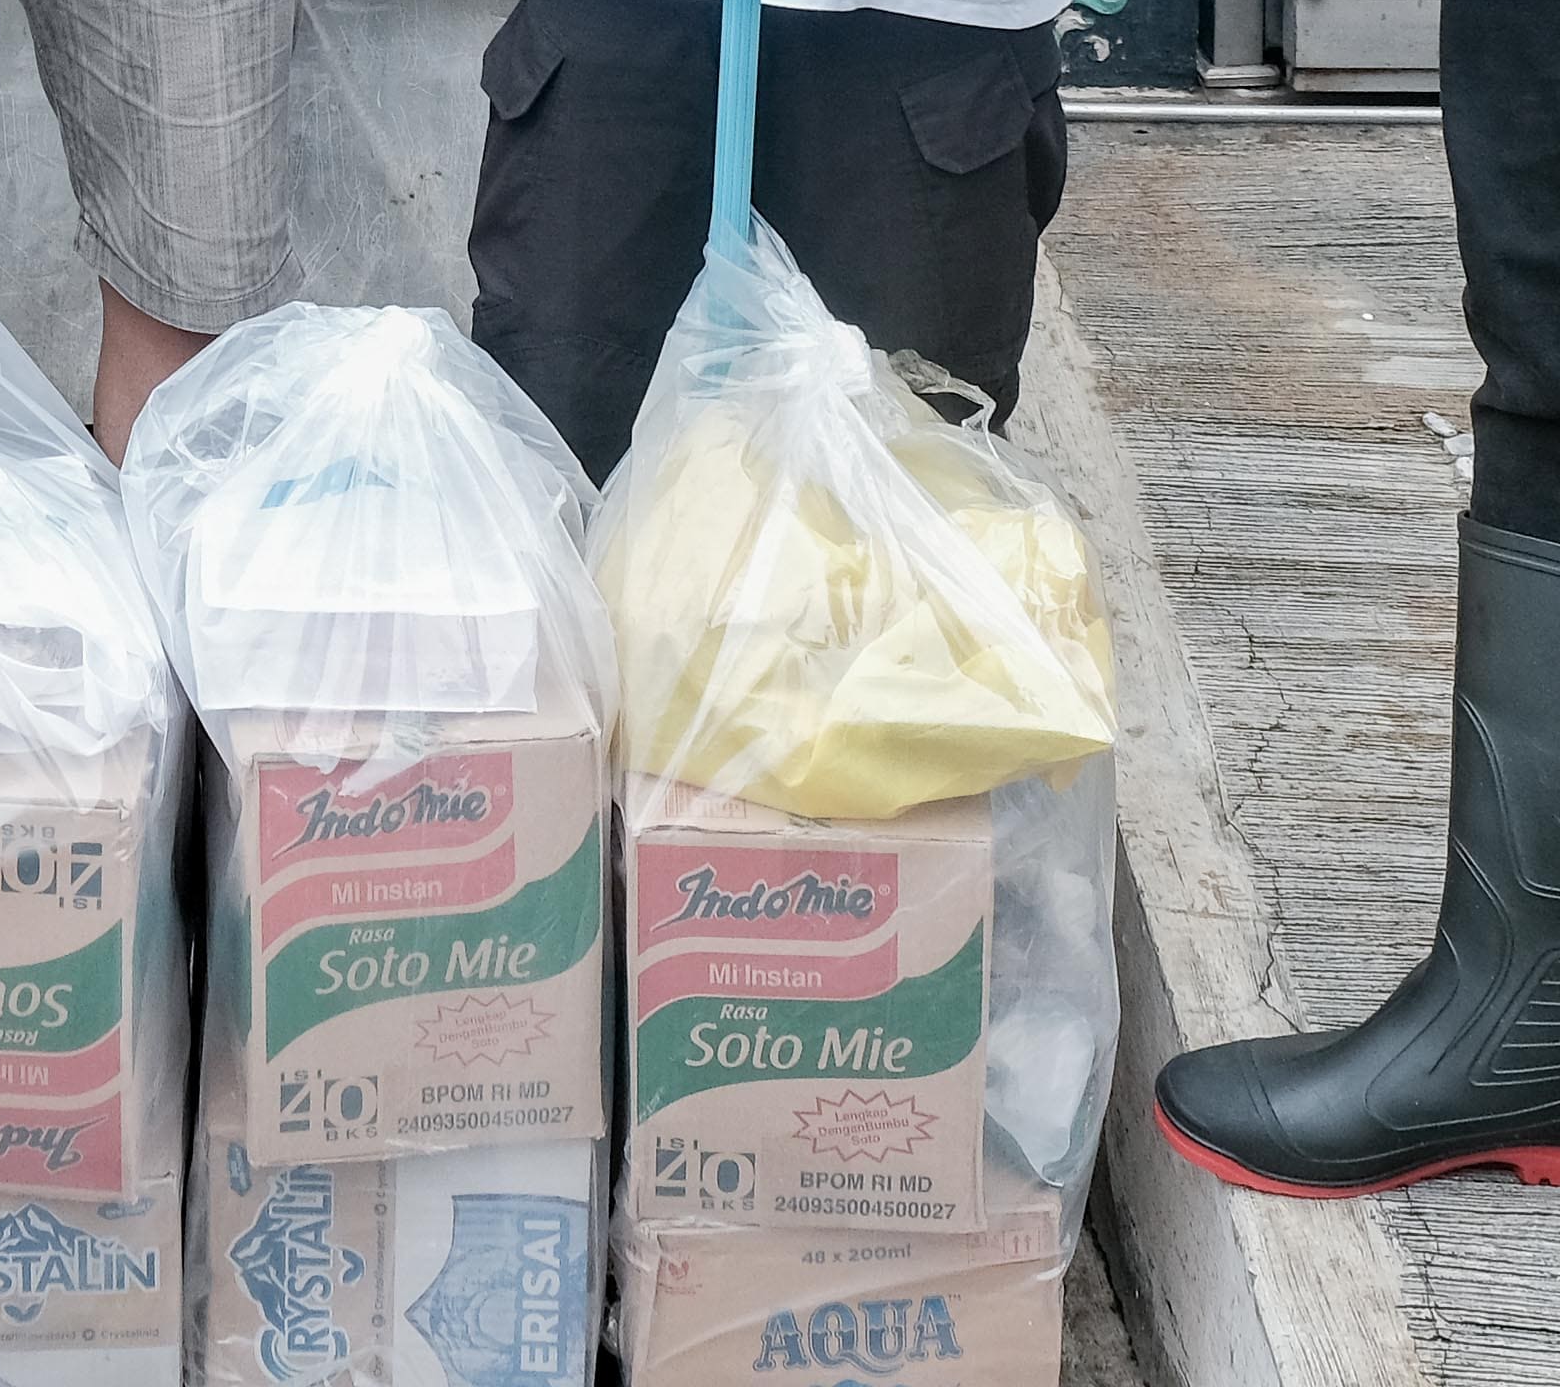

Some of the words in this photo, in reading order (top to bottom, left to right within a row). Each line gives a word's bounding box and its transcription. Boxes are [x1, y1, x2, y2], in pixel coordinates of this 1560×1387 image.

[0, 841, 103, 897] 40
[366, 878, 443, 902] Instan
[59, 897, 103, 911] ISI
[348, 926, 396, 945] Rasa
[314, 945, 430, 996] Soto
[444, 935, 537, 984] Mie
[744, 963, 824, 988] Instan
[719, 1003, 769, 1021] Rasa
[685, 1022, 804, 1070] Soto
[816, 1026, 914, 1073] Mie
[279, 1075, 378, 1134] 40
[421, 1083, 484, 1105] BPOM
[491, 1082, 513, 1102] RI
[519, 1080, 552, 1100] MD
[396, 1106, 574, 1135] 240935004500027
[834, 1107, 890, 1124] Lengkap
[325, 1127, 378, 1143] BKS
[655, 1136, 699, 1151] ISI
[850, 1133, 881, 1146] Soto
[655, 1148, 756, 1199] 40
[799, 1171, 865, 1192] BPOM
[870, 1174, 893, 1193] RI
[899, 1175, 934, 1194] MD
[700, 1198, 756, 1212] BKS
[774, 1196, 957, 1221] 240935004500027
[800, 1248, 826, 1266] 48
[848, 1244, 913, 1263] 200ml
[752, 1294, 965, 1377] AQUA
